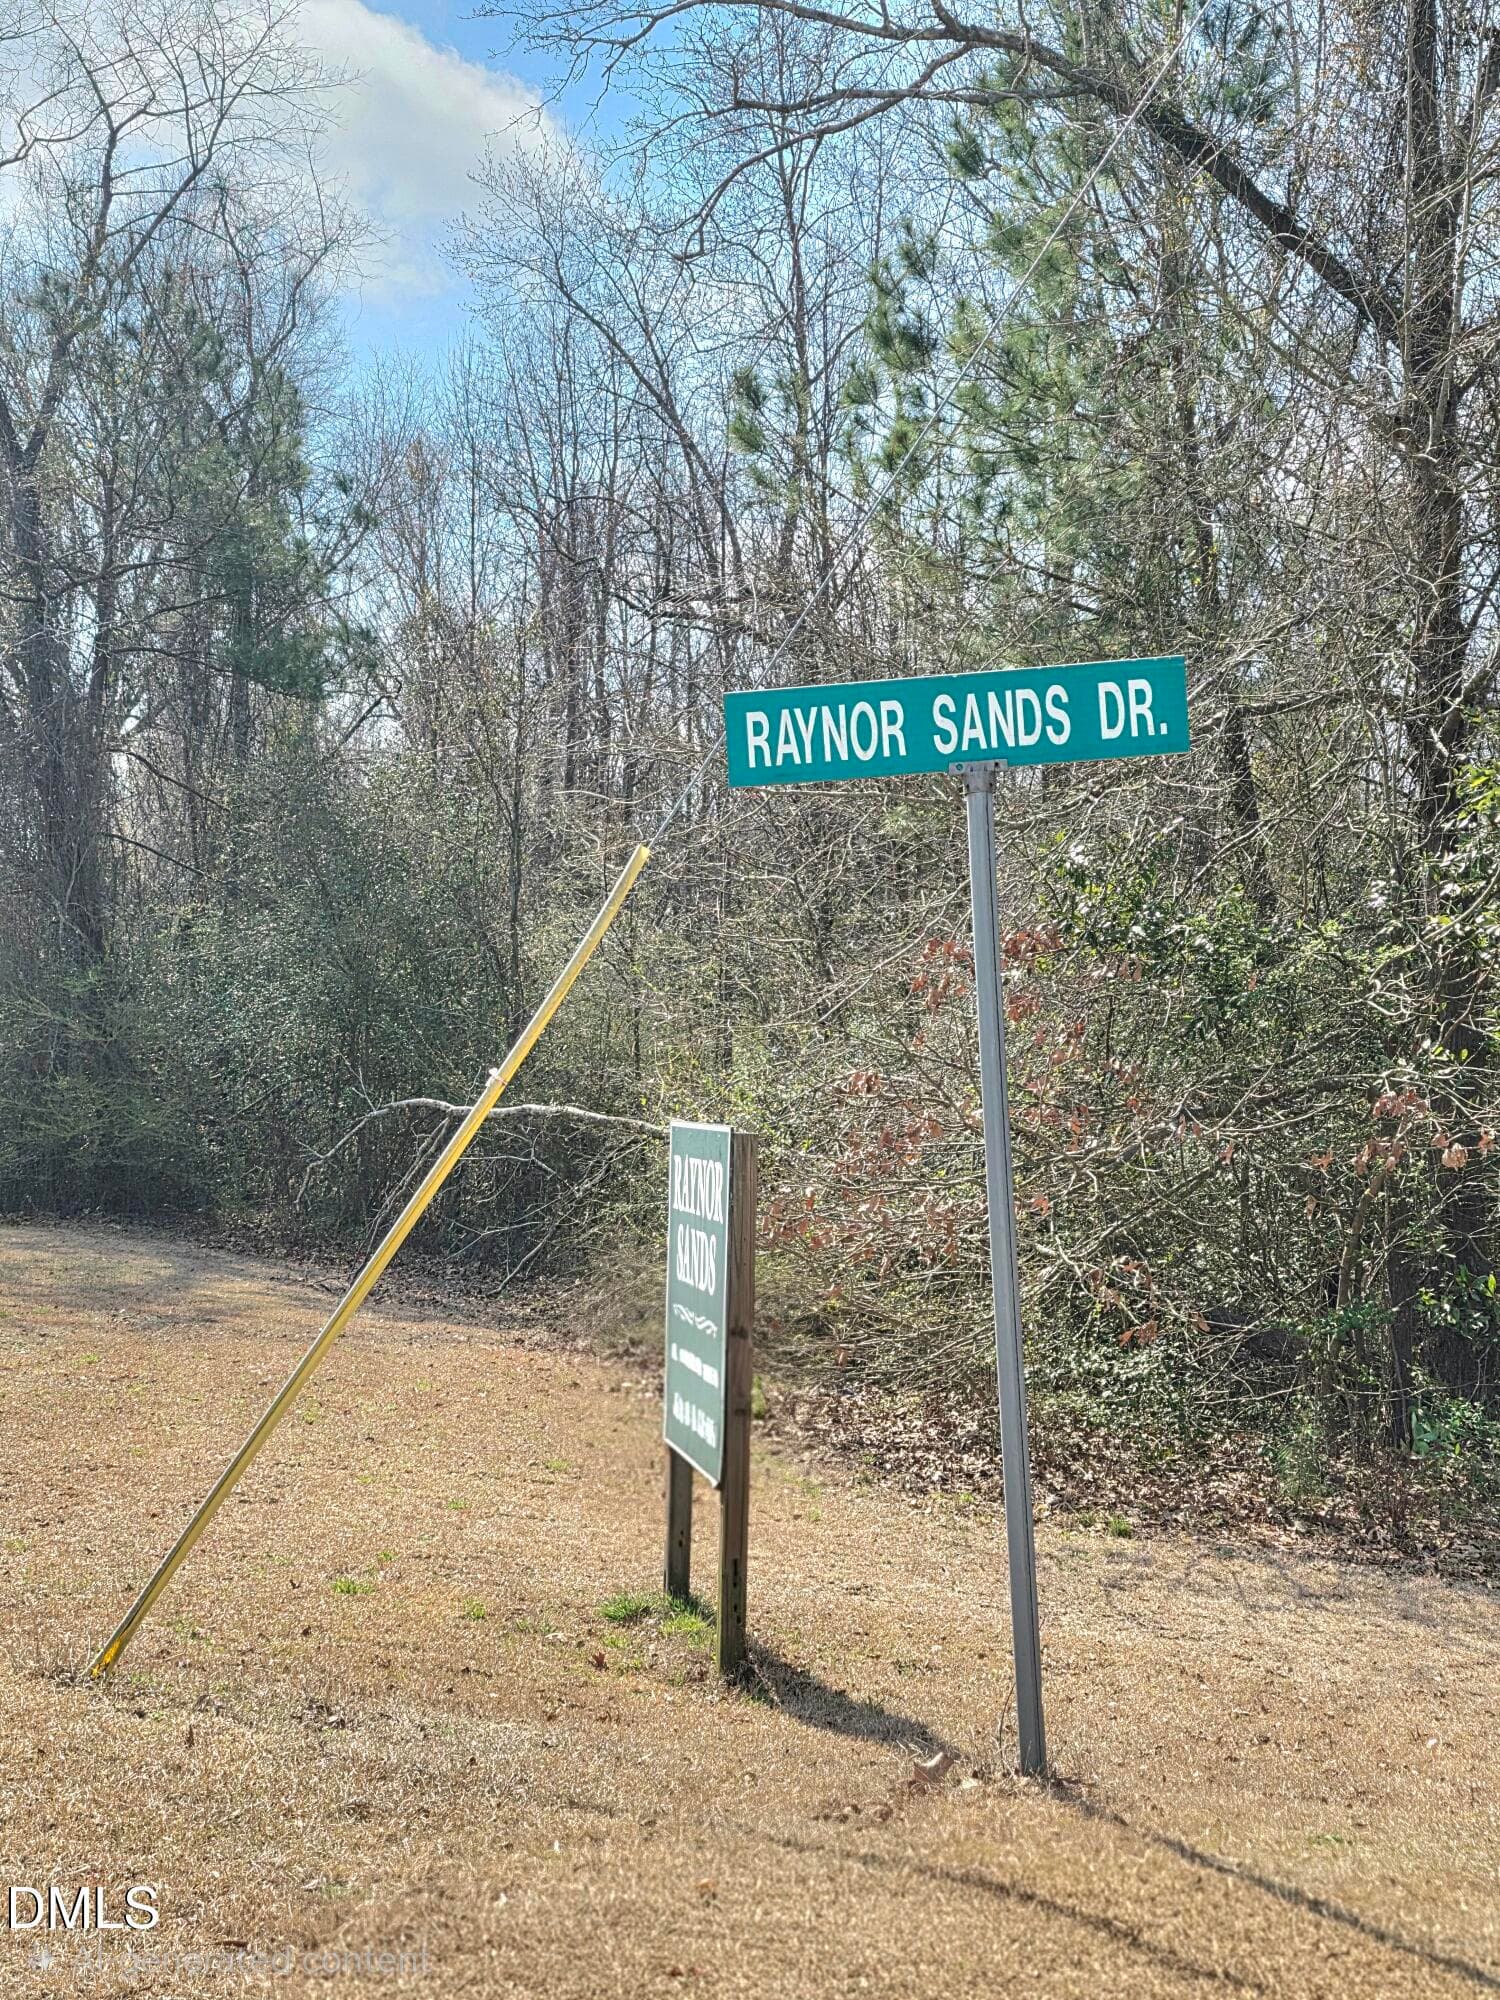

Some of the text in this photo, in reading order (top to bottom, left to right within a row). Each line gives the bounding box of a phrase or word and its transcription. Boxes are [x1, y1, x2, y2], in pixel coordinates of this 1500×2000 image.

[746, 678, 1168, 768] RAYNOR SANDS DR.
[673, 1154, 724, 1225] RAYNOR
[676, 1223, 717, 1296] SANDS
